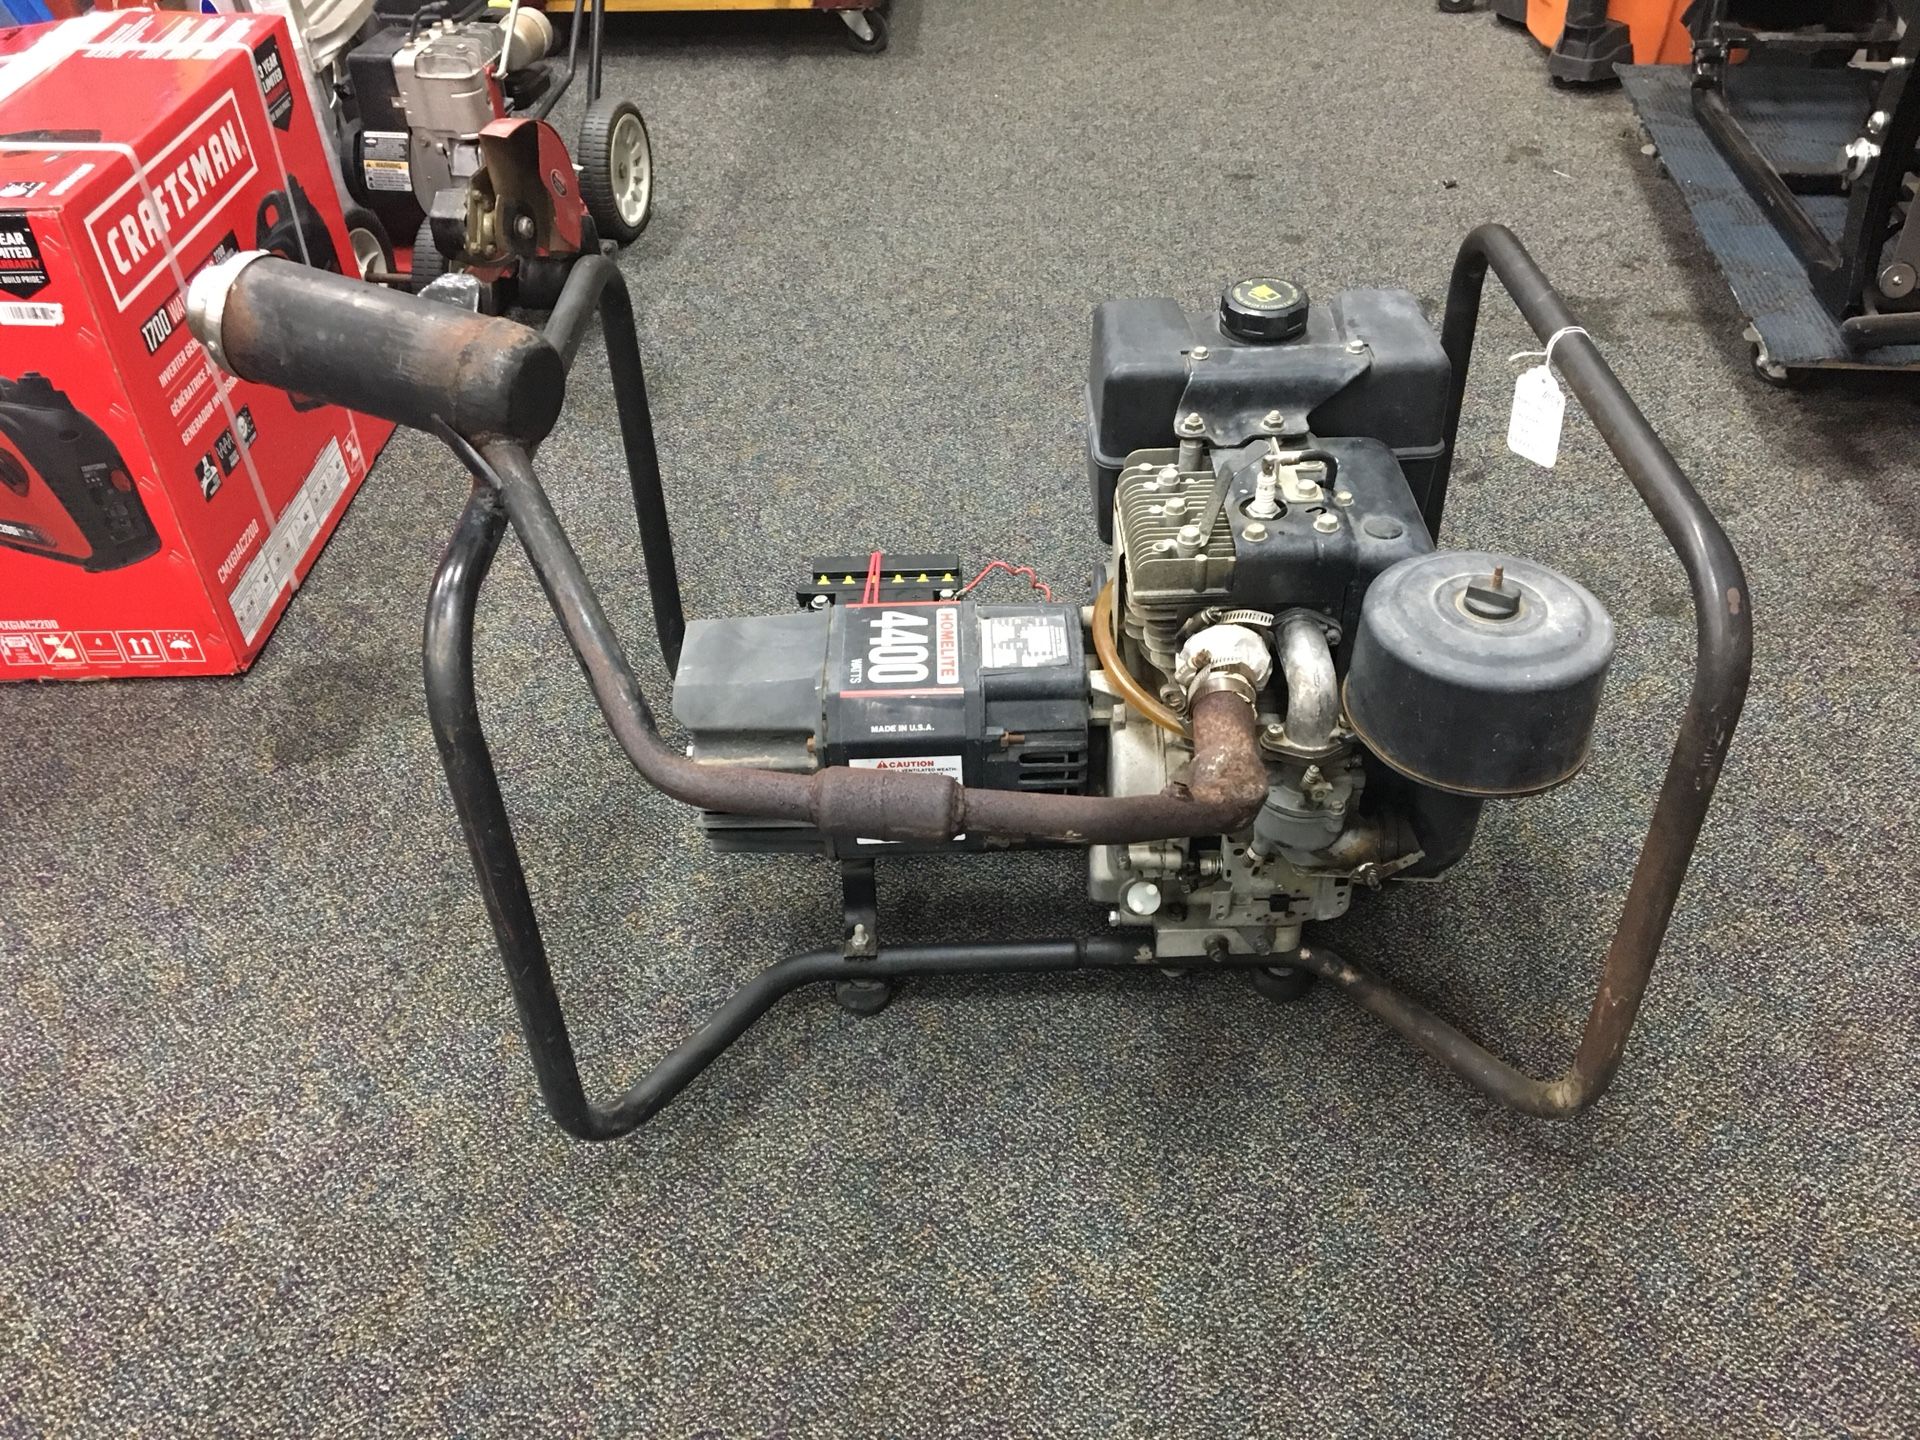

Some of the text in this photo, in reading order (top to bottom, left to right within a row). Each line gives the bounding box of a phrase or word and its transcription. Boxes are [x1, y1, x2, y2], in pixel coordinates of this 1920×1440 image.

[261, 52, 279, 76] YEAR
[106, 119, 243, 276] CRAFTSMAN
[141, 308, 173, 353] 1700
[158, 350, 188, 388] INVERTER
[181, 400, 215, 446] GENERADOR
[867, 610, 929, 684] 4400
[940, 613, 955, 677] HOMELITE
[849, 658, 863, 684] WATTS
[870, 723, 935, 734] MADE IN U.S.A.
[889, 761, 935, 769] CAUTION
